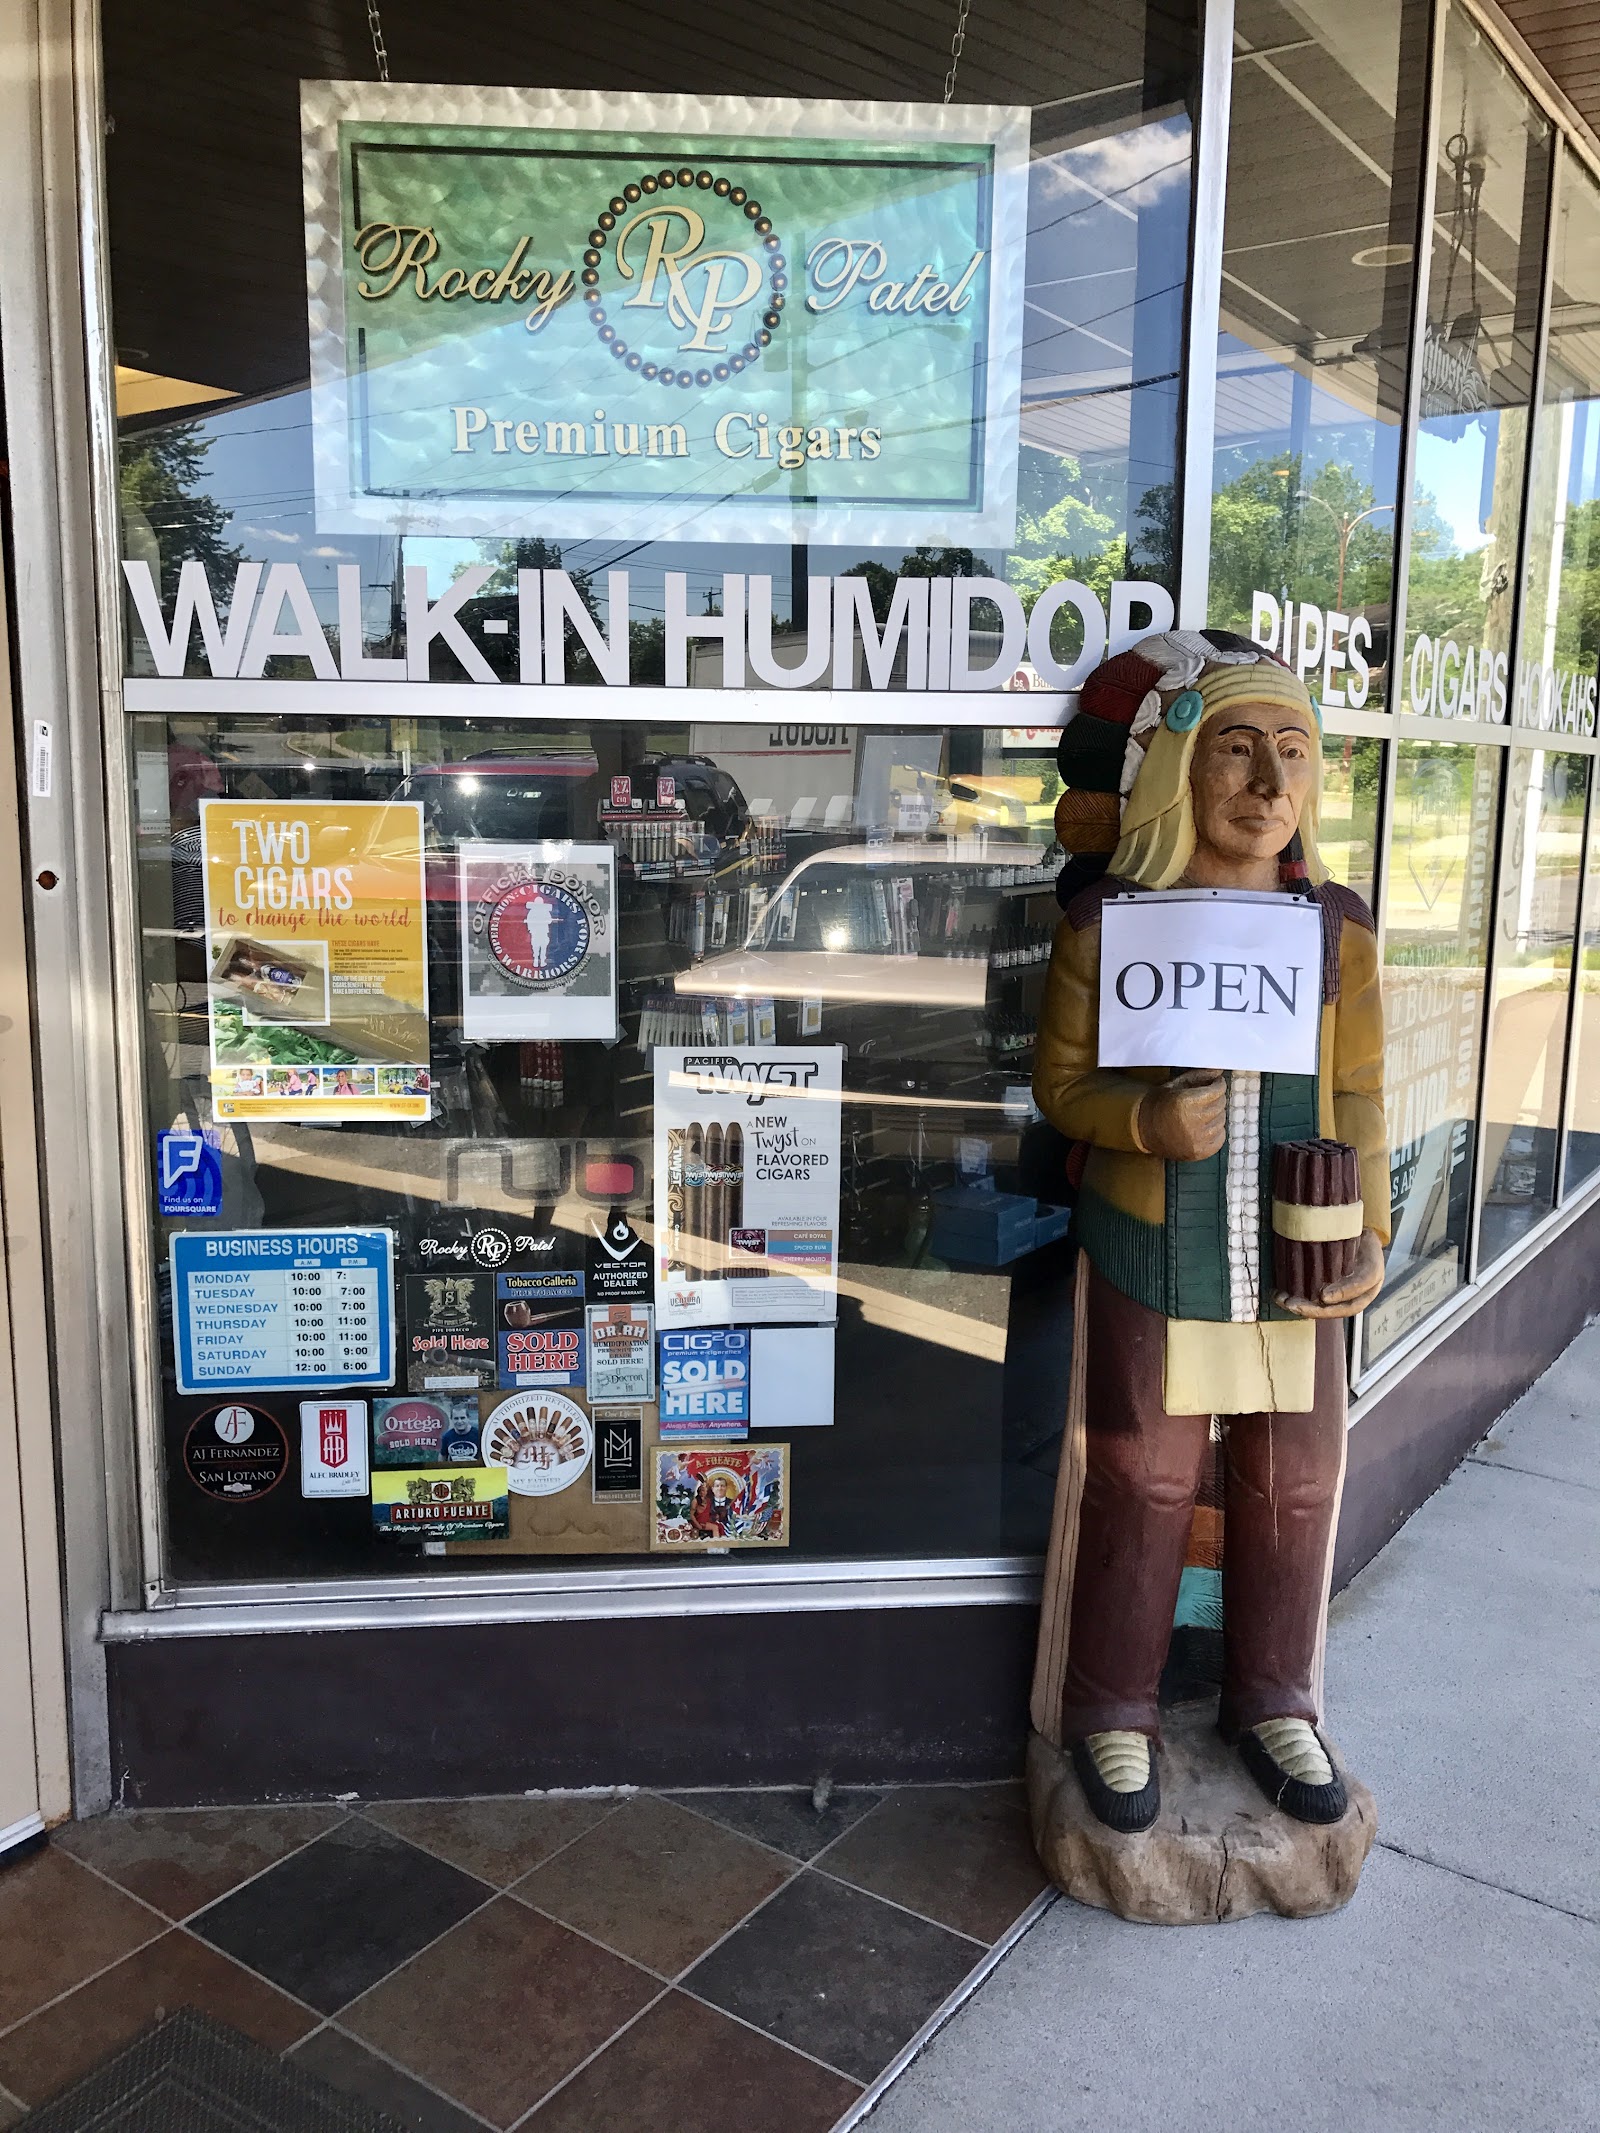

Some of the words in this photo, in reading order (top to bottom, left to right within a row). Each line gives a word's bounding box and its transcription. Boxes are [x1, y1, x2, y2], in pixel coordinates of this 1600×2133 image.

[352, 222, 575, 331] Rocky
[805, 236, 985, 314] Patel
[450, 406, 690, 459] Premium
[714, 412, 882, 469] Cigars
[121, 560, 630, 686] WALK-IN
[1251, 589, 1373, 709] PIPES
[1410, 633, 1509, 724] CIGARS
[1521, 660, 1598, 737] HOOKAHS
[232, 820, 310, 865] TWO
[234, 866, 353, 910] CIGARS
[472, 868, 543, 934] OFFICIAL
[549, 868, 607, 936] DONOR
[519, 884, 581, 914] CIGARS
[217, 907, 239, 927] to
[246, 907, 312, 933] change
[318, 907, 349, 927] the
[355, 907, 412, 928] world
[574, 918, 589, 954] FOR
[502, 954, 579, 979] WARRIORS
[1116, 961, 1304, 1016] OPEN
[1405, 978, 1456, 1029] BOLD
[1411, 1020, 1452, 1073] FRONTAL
[755, 1116, 787, 1128] NEW
[751, 1127, 800, 1153] Twyst
[802, 1137, 816, 1146] ON
[757, 1154, 829, 1166] FLAVORED
[756, 1168, 811, 1180] CIGARS
[164, 1205, 217, 1213] FOURSQUARE
[206, 1239, 293, 1257] BUSINESS
[297, 1237, 358, 1255] HOURS
[419, 1239, 468, 1260] Rocky
[514, 1236, 557, 1252] Patel
[195, 1274, 250, 1284] MONDAY
[291, 1272, 320, 1280] 10:00
[337, 1271, 347, 1280] 7:
[507, 1277, 542, 1288] Tobacco
[543, 1276, 577, 1287] Galleria
[593, 1271, 648, 1280] AUTHORIZED
[603, 1280, 638, 1288] DEALER
[195, 1288, 255, 1299] TUESDAY
[293, 1287, 321, 1295] 10:00
[341, 1287, 366, 1295] 7:00
[195, 1303, 278, 1314] WEDNESDAY
[294, 1303, 322, 1311] 10:00
[342, 1302, 366, 1310] 7:00
[196, 1319, 267, 1330] THURSDAY
[295, 1318, 323, 1327] 10:00
[338, 1317, 367, 1326] 11:00
[622, 1324, 646, 1338] RH
[197, 1335, 244, 1345] FRIDAY
[297, 1332, 326, 1341] 10:00
[339, 1332, 368, 1341] 11:00
[412, 1335, 447, 1351] Sold
[451, 1335, 489, 1351] Here
[507, 1332, 579, 1352] SOLD
[198, 1350, 267, 1361] SATURDAY
[295, 1348, 325, 1357] 10:00
[343, 1347, 368, 1355] 9:00
[507, 1351, 579, 1372] HERE
[199, 1365, 252, 1376] SUNDAY
[343, 1362, 367, 1370] 6:00
[663, 1360, 746, 1383] SOLD
[492, 1394, 543, 1426] AUTHORIZED
[544, 1395, 582, 1424] RETAILER
[666, 1391, 743, 1415] HERE
[385, 1415, 442, 1432] Ortega
[389, 1438, 410, 1449] SOLD
[414, 1437, 438, 1446] HERE
[193, 1450, 206, 1460] AJ
[705, 1456, 743, 1468] FUENTE
[395, 1506, 440, 1519] ARTURO
[443, 1504, 488, 1517] FUENTE
[379, 1524, 392, 1532] The
[422, 1523, 446, 1531] Family
